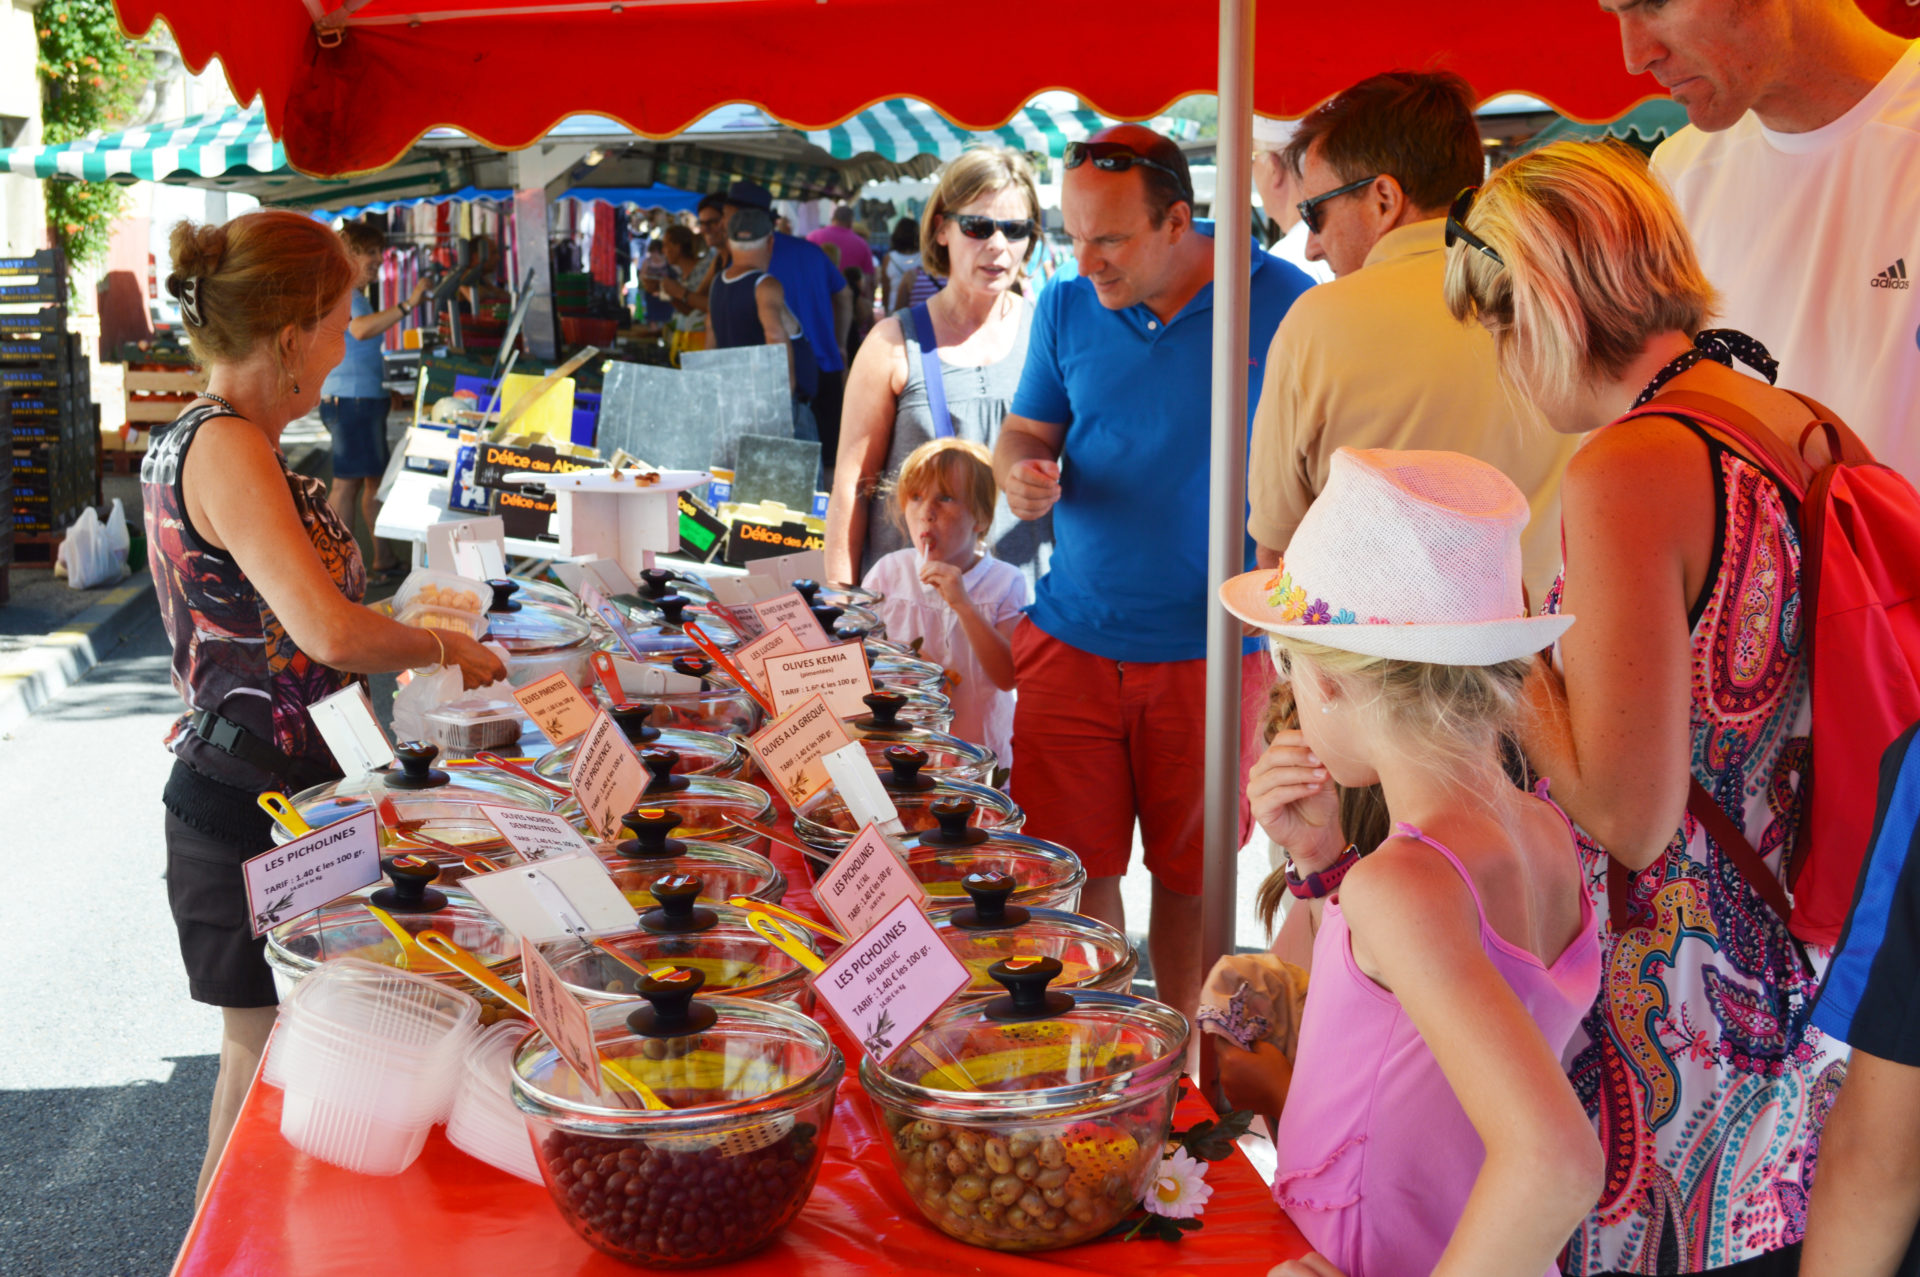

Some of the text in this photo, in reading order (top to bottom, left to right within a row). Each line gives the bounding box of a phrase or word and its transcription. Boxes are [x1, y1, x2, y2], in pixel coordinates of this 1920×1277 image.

[1870, 277, 1909, 290] adidas
[487, 448, 530, 468] Délice
[531, 461, 550, 473] des
[501, 493, 534, 509] Délice
[534, 500, 549, 511] des
[740, 524, 783, 544] Délice
[783, 536, 801, 548] des
[750, 650, 761, 661] LES
[782, 653, 847, 672] OLIVES KEMIA
[521, 693, 540, 705] OLIVES
[781, 687, 800, 696] TARIF
[837, 678, 849, 686] 100
[761, 735, 785, 757] OLIVES
[784, 731, 791, 741] A
[789, 724, 800, 736] LA
[799, 703, 826, 728] GREQUE
[574, 719, 610, 788] OLIVES AUX HERBES
[584, 775, 593, 791] DE
[591, 740, 612, 778] PROVENCE
[779, 758, 794, 772] TARIF
[816, 732, 826, 743] 100
[265, 826, 356, 872] LES PICHOLINES
[832, 842, 875, 896] LES PICHOLINES
[264, 880, 289, 895] TARIF
[296, 869, 314, 882] 1.40
[315, 865, 321, 873] €
[323, 861, 335, 870] les
[336, 852, 352, 864] 100
[353, 849, 366, 859] gr.
[847, 904, 862, 922] TARIF
[860, 891, 872, 906] 1.40
[872, 880, 880, 890] les
[877, 870, 888, 884] 100
[834, 920, 907, 990] LES PICHOLINES
[865, 950, 901, 985] AU BASILIC
[852, 995, 874, 1017] TARIF
[876, 979, 893, 997] 1.40
[891, 972, 899, 981] €
[898, 965, 908, 977] les
[906, 951, 921, 968] 100
[921, 943, 932, 957] gr.
